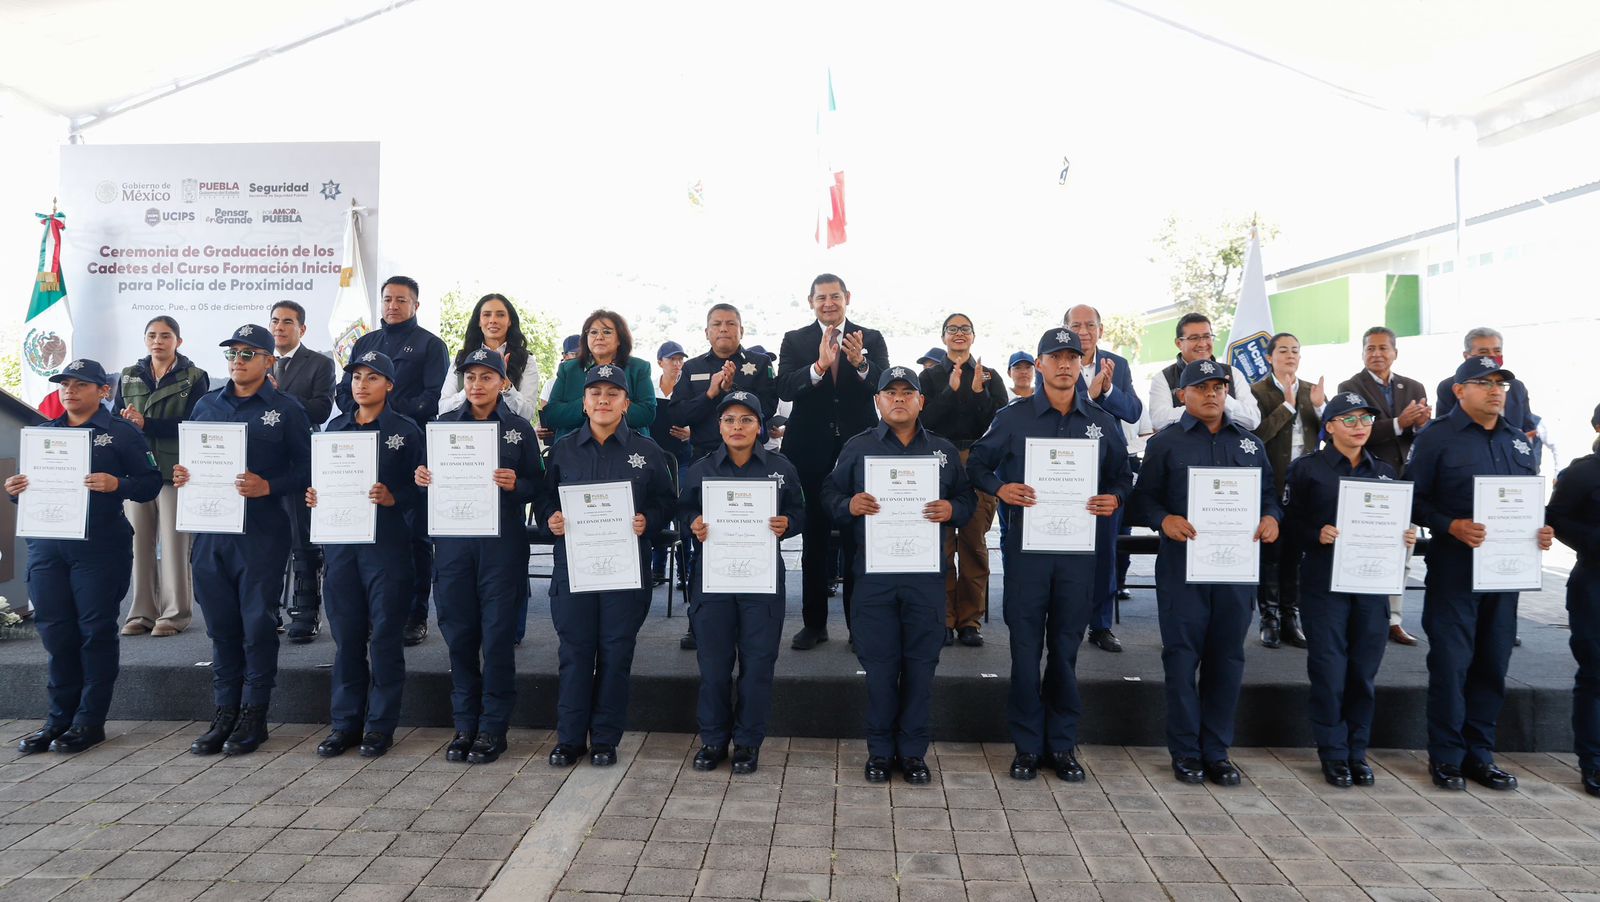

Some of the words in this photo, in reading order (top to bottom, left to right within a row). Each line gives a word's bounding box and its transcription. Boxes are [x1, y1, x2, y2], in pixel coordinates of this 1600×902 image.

[199, 182, 240, 191] PUEBLA
[249, 182, 309, 194] Seguridad
[122, 189, 171, 201] México
[162, 212, 196, 221] UCIPS
[215, 208, 248, 216] Pensar
[216, 216, 253, 224] Grande
[262, 215, 302, 223] PUEBLA
[100, 245, 178, 258] Ceremonia
[182, 246, 200, 258] de
[203, 245, 288, 258] Graduación
[292, 245, 310, 257] de
[314, 244, 334, 257] los
[87, 262, 148, 274] Cadetes
[152, 262, 174, 274] del
[177, 262, 220, 274] Curso
[222, 261, 298, 274] Formación
[302, 261, 342, 274] Inicia
[118, 281, 152, 294] para
[157, 279, 204, 291] Policía
[208, 279, 226, 291] de
[230, 279, 314, 291] Proximidad
[132, 303, 166, 312] Amozoc,
[1247, 341, 1267, 374] UCIPS
